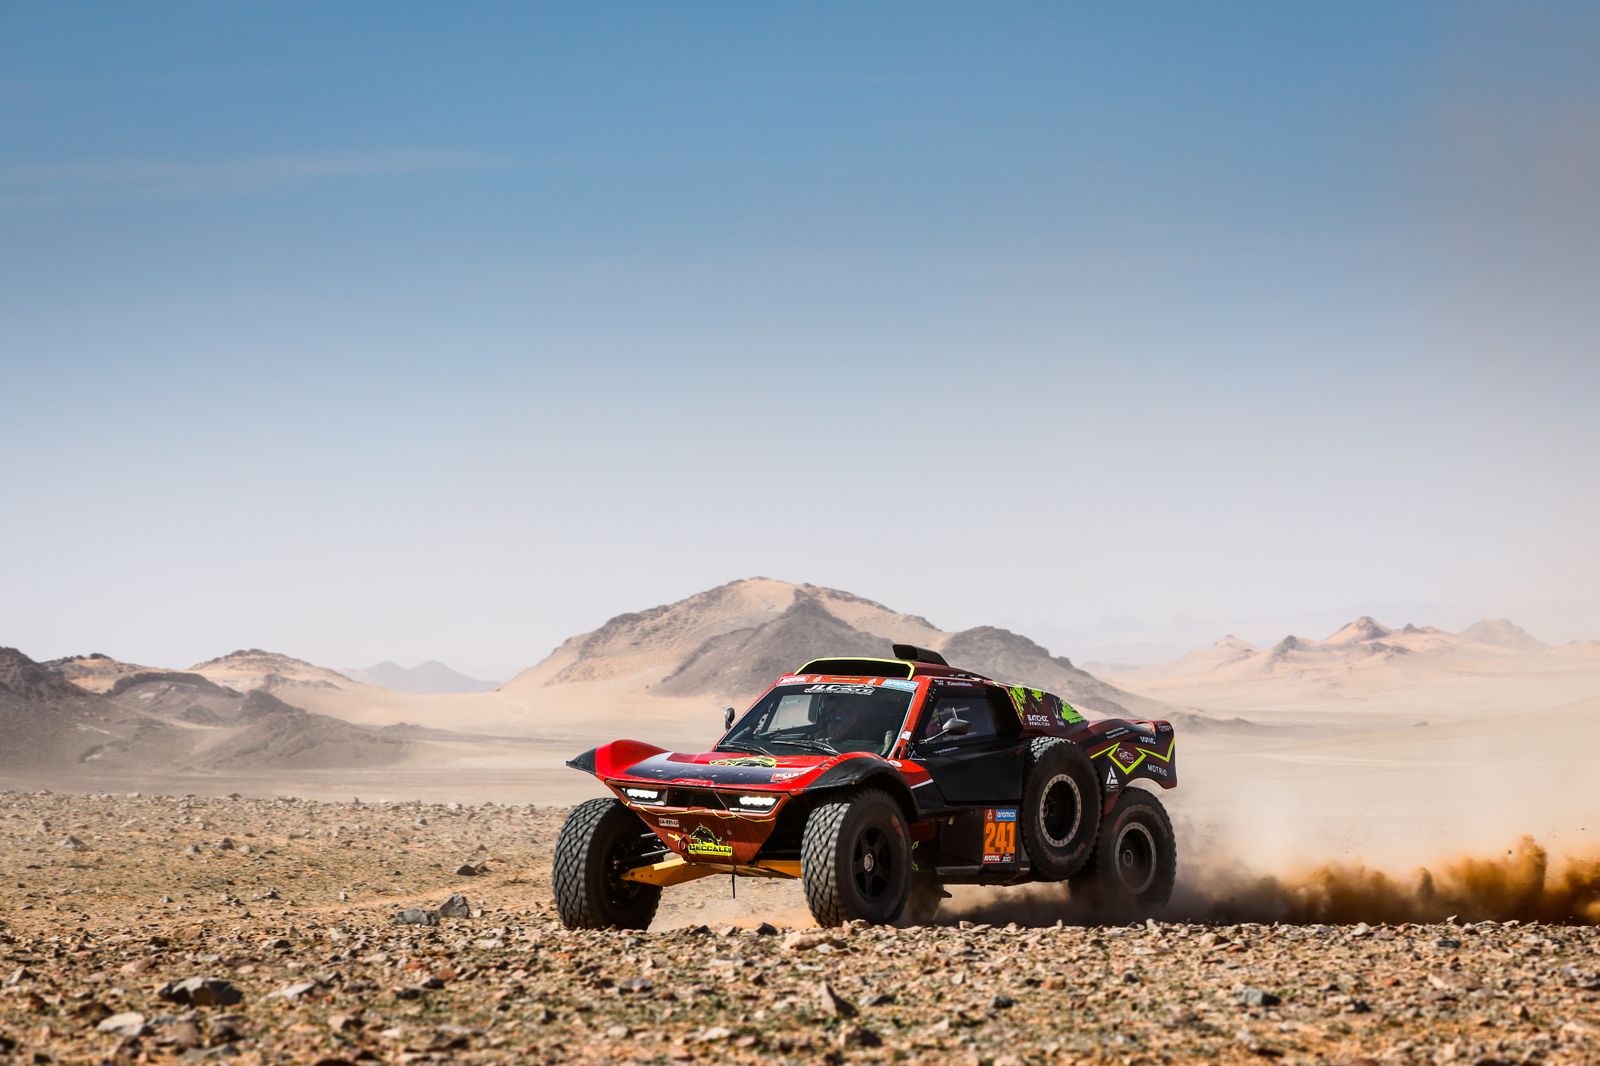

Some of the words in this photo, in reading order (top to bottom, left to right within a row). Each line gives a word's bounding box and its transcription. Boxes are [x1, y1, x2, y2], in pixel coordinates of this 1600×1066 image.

[1147, 763, 1168, 777] MOTRIO
[985, 822, 1015, 854] 241
[984, 854, 1000, 862] MOTUL
